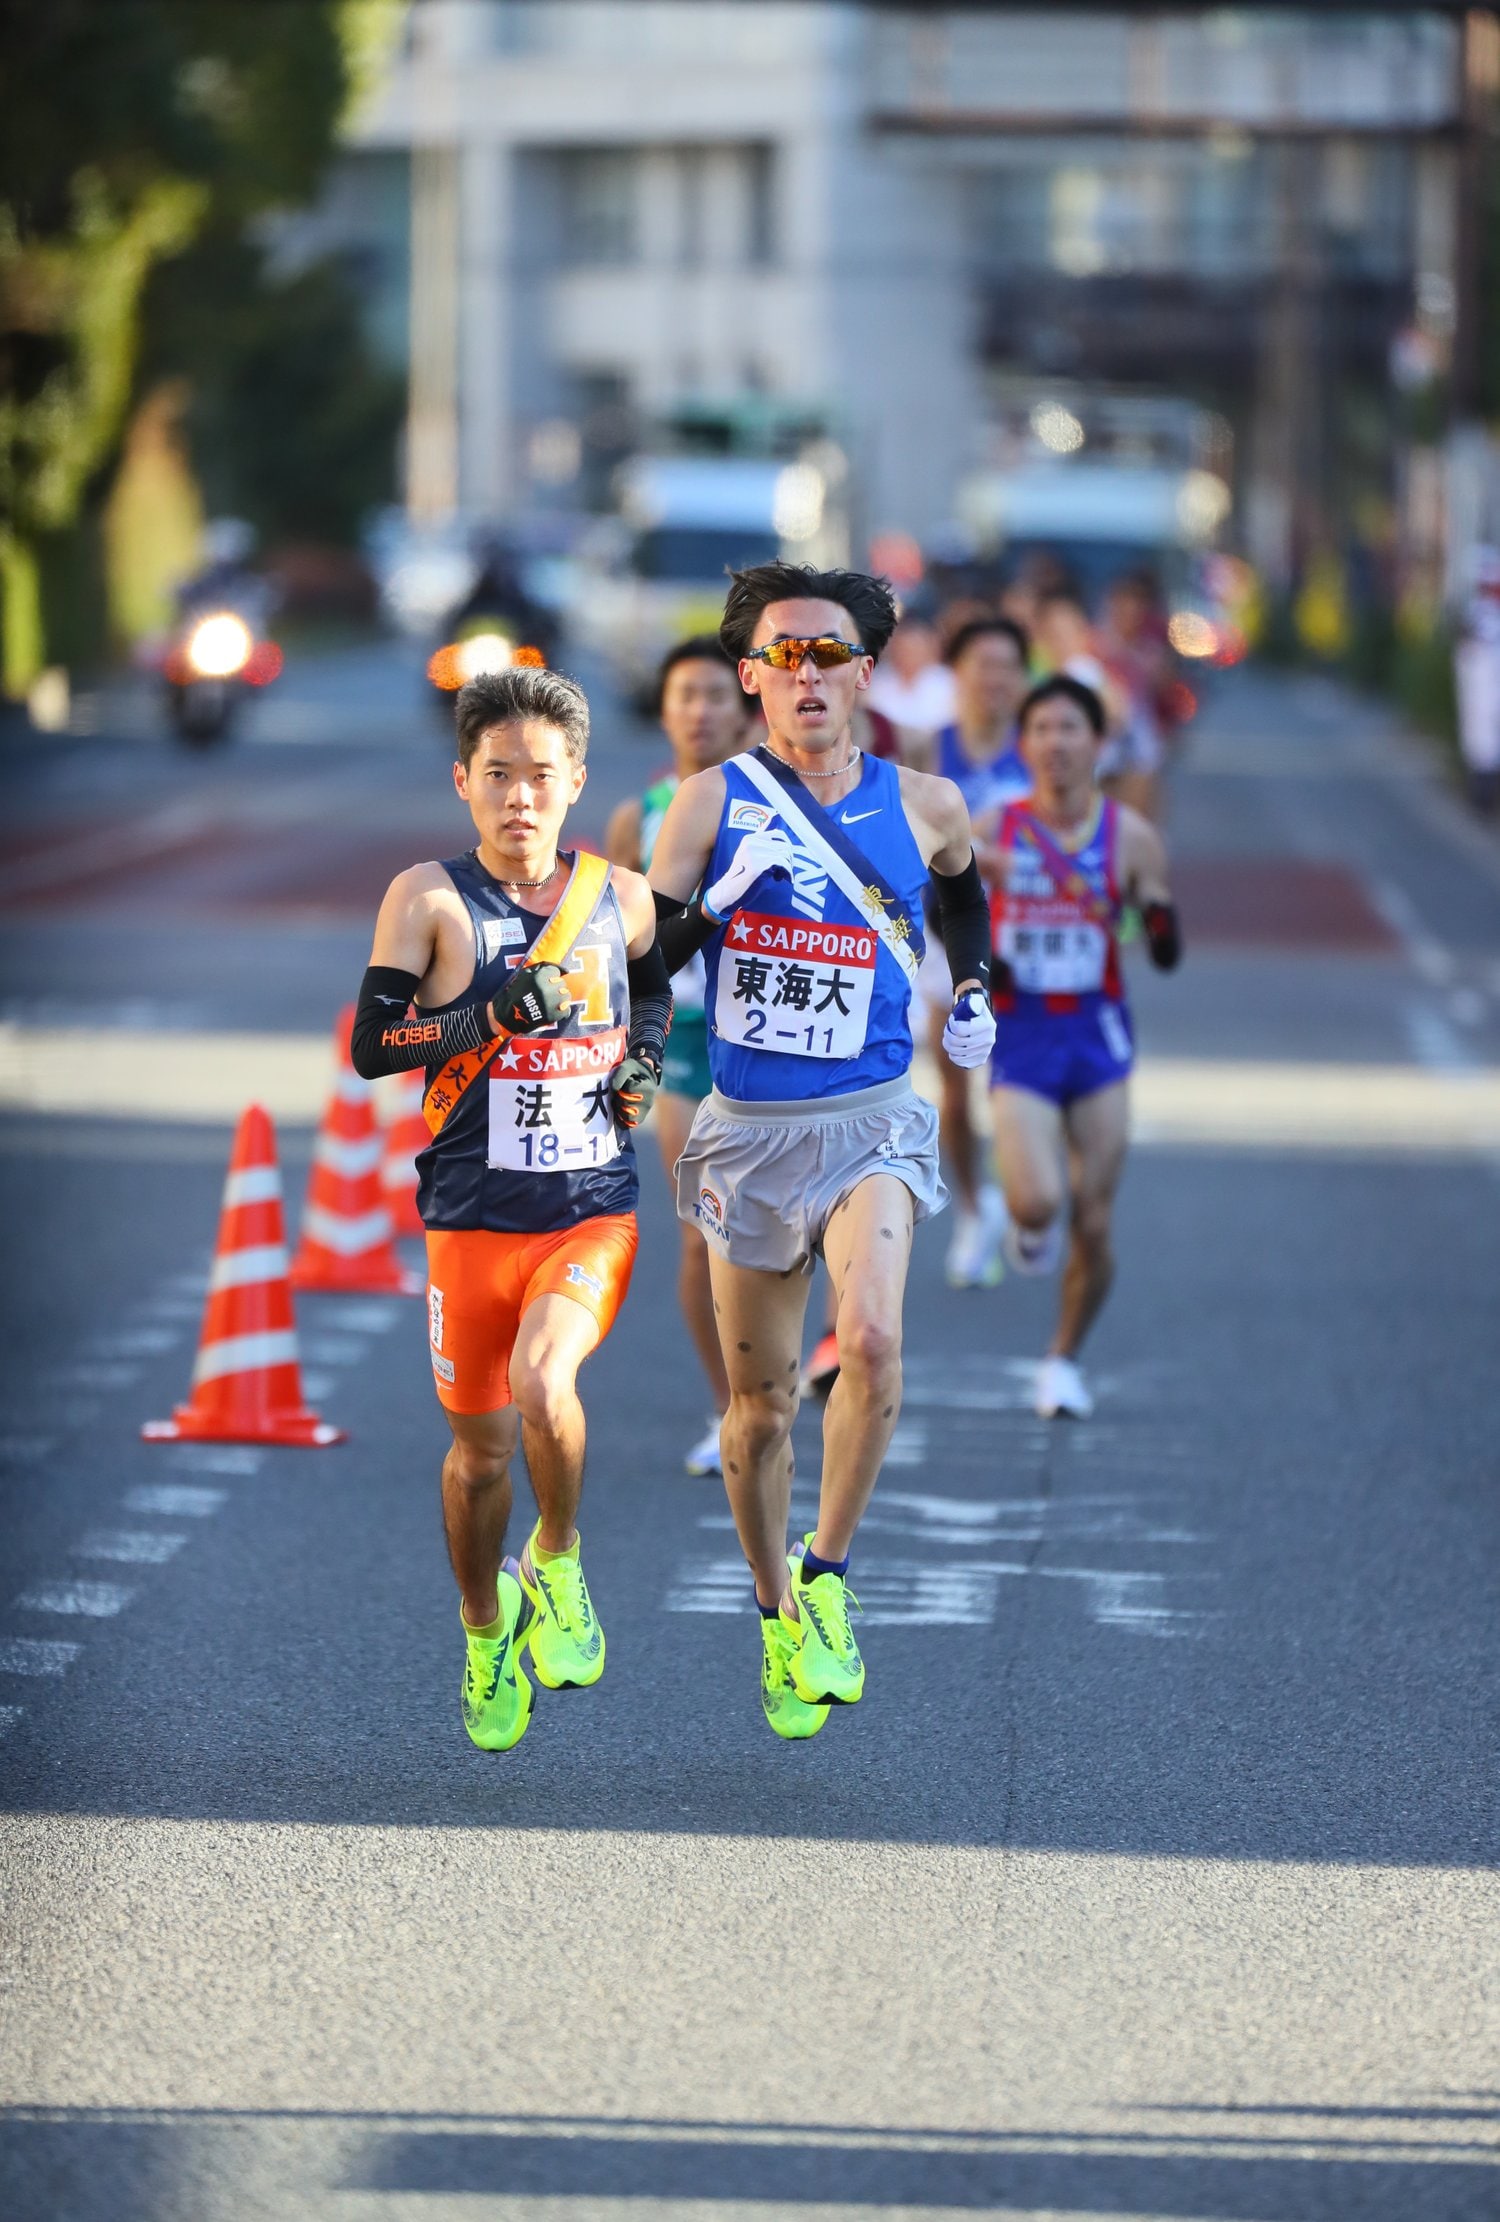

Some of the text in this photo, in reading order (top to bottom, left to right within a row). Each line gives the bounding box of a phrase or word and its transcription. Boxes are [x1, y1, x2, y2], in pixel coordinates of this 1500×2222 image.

[757, 924, 871, 961] SAPPORO
[733, 956, 855, 1017] 東海大
[522, 991, 543, 1022] HOSEI
[382, 1022, 442, 1047] HOSEI
[742, 1009, 834, 1054] 2-11
